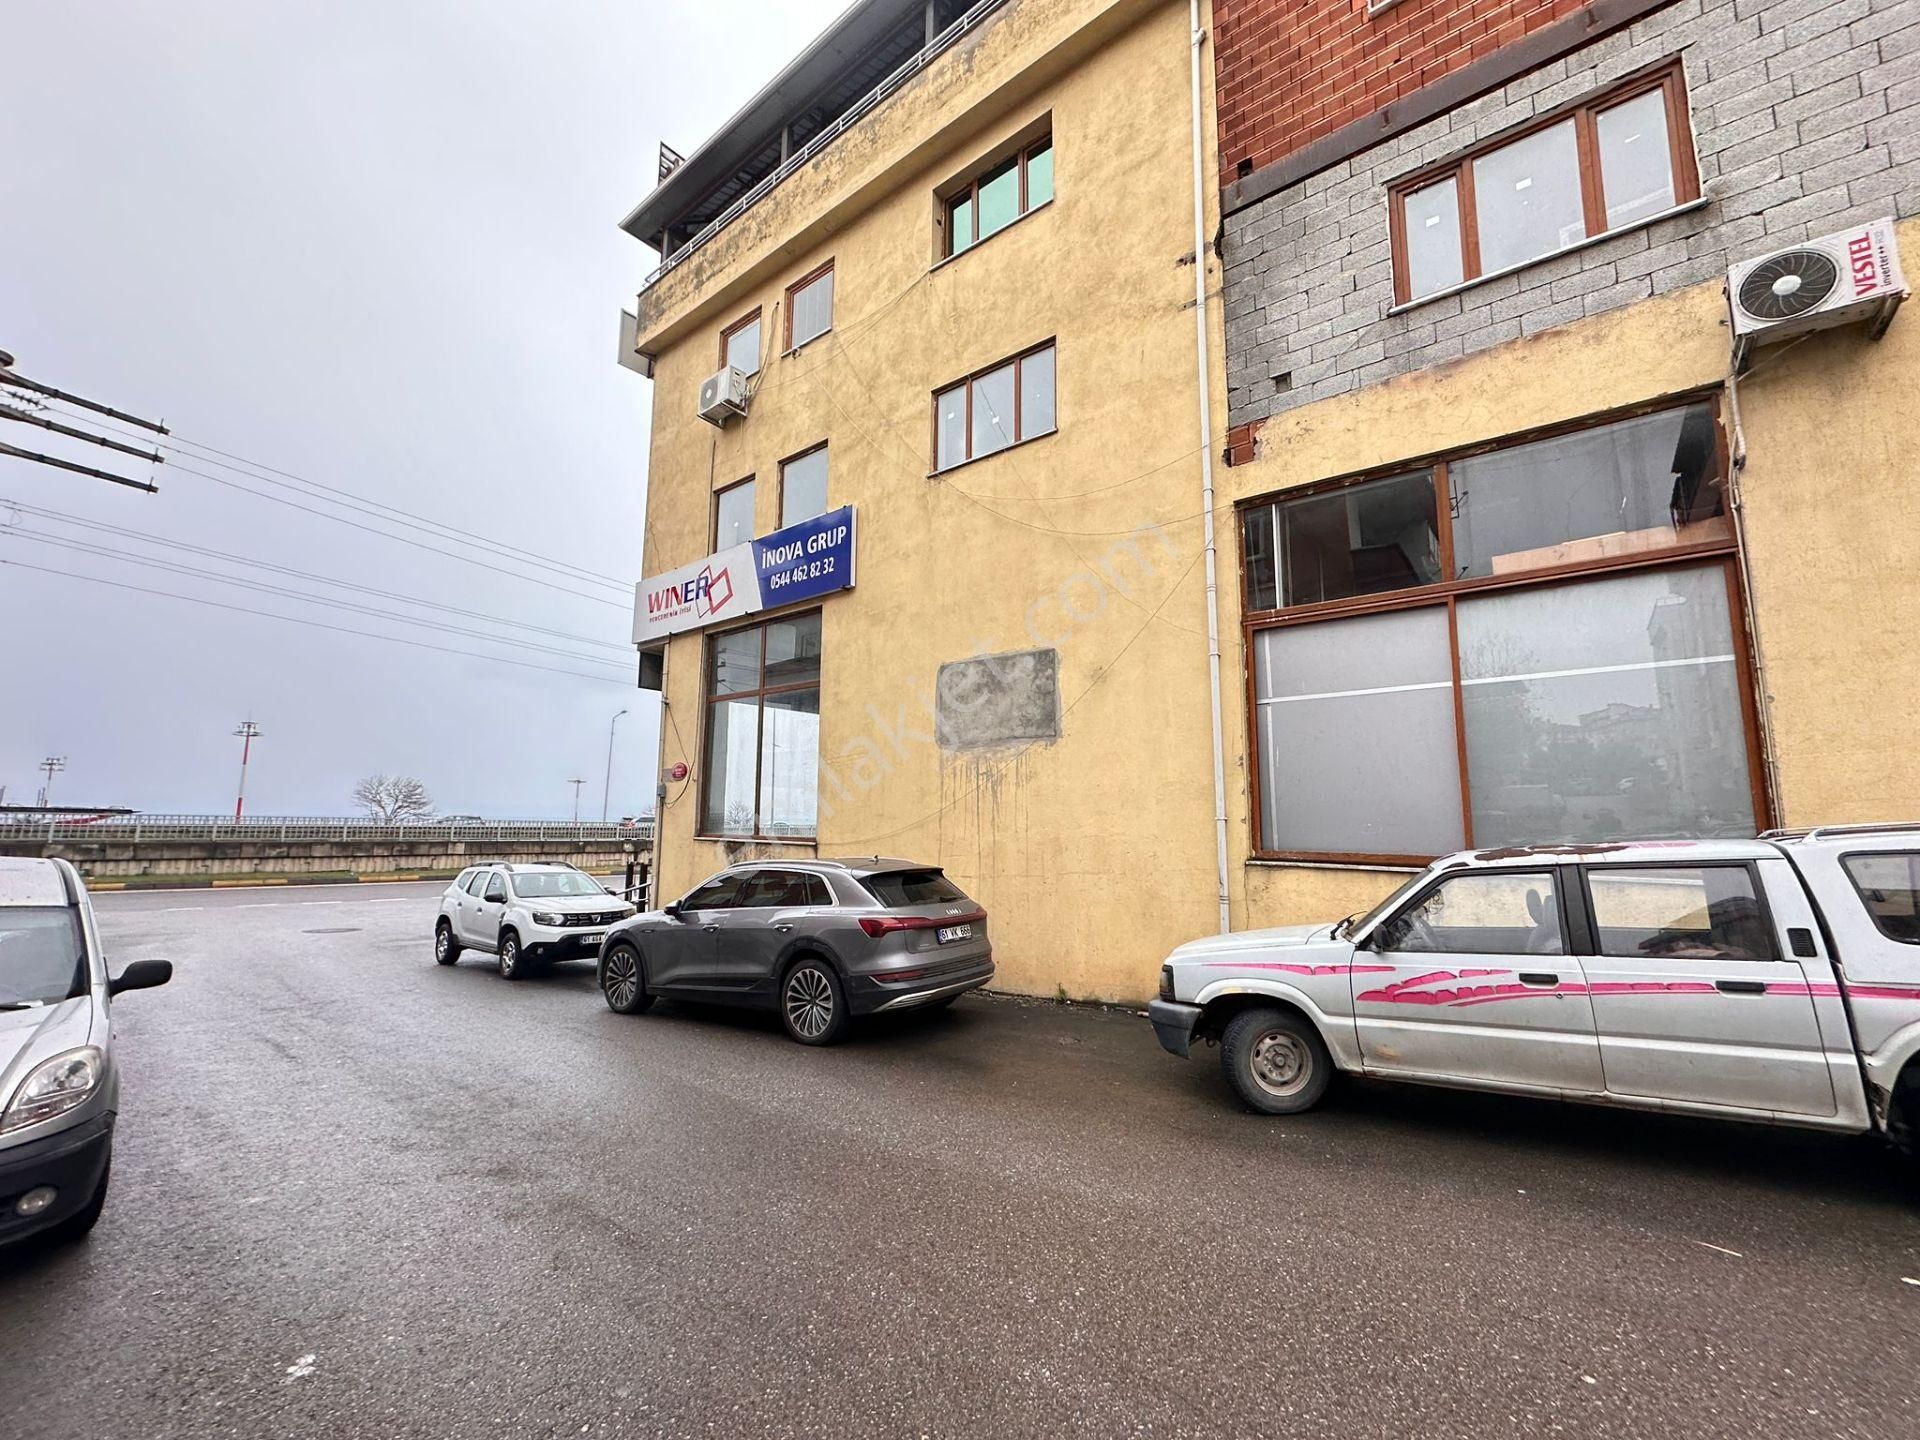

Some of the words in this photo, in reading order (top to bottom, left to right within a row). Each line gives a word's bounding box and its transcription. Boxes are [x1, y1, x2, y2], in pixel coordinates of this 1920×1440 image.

[1848, 231, 1877, 296] VESTEL
[761, 539, 804, 570] İNOVA
[806, 525, 847, 554] GRUP
[648, 575, 709, 614] WINER
[770, 572, 791, 590] 0544
[791, 564, 808, 583] 462
[810, 561, 821, 578] 82
[822, 557, 834, 574] 32
